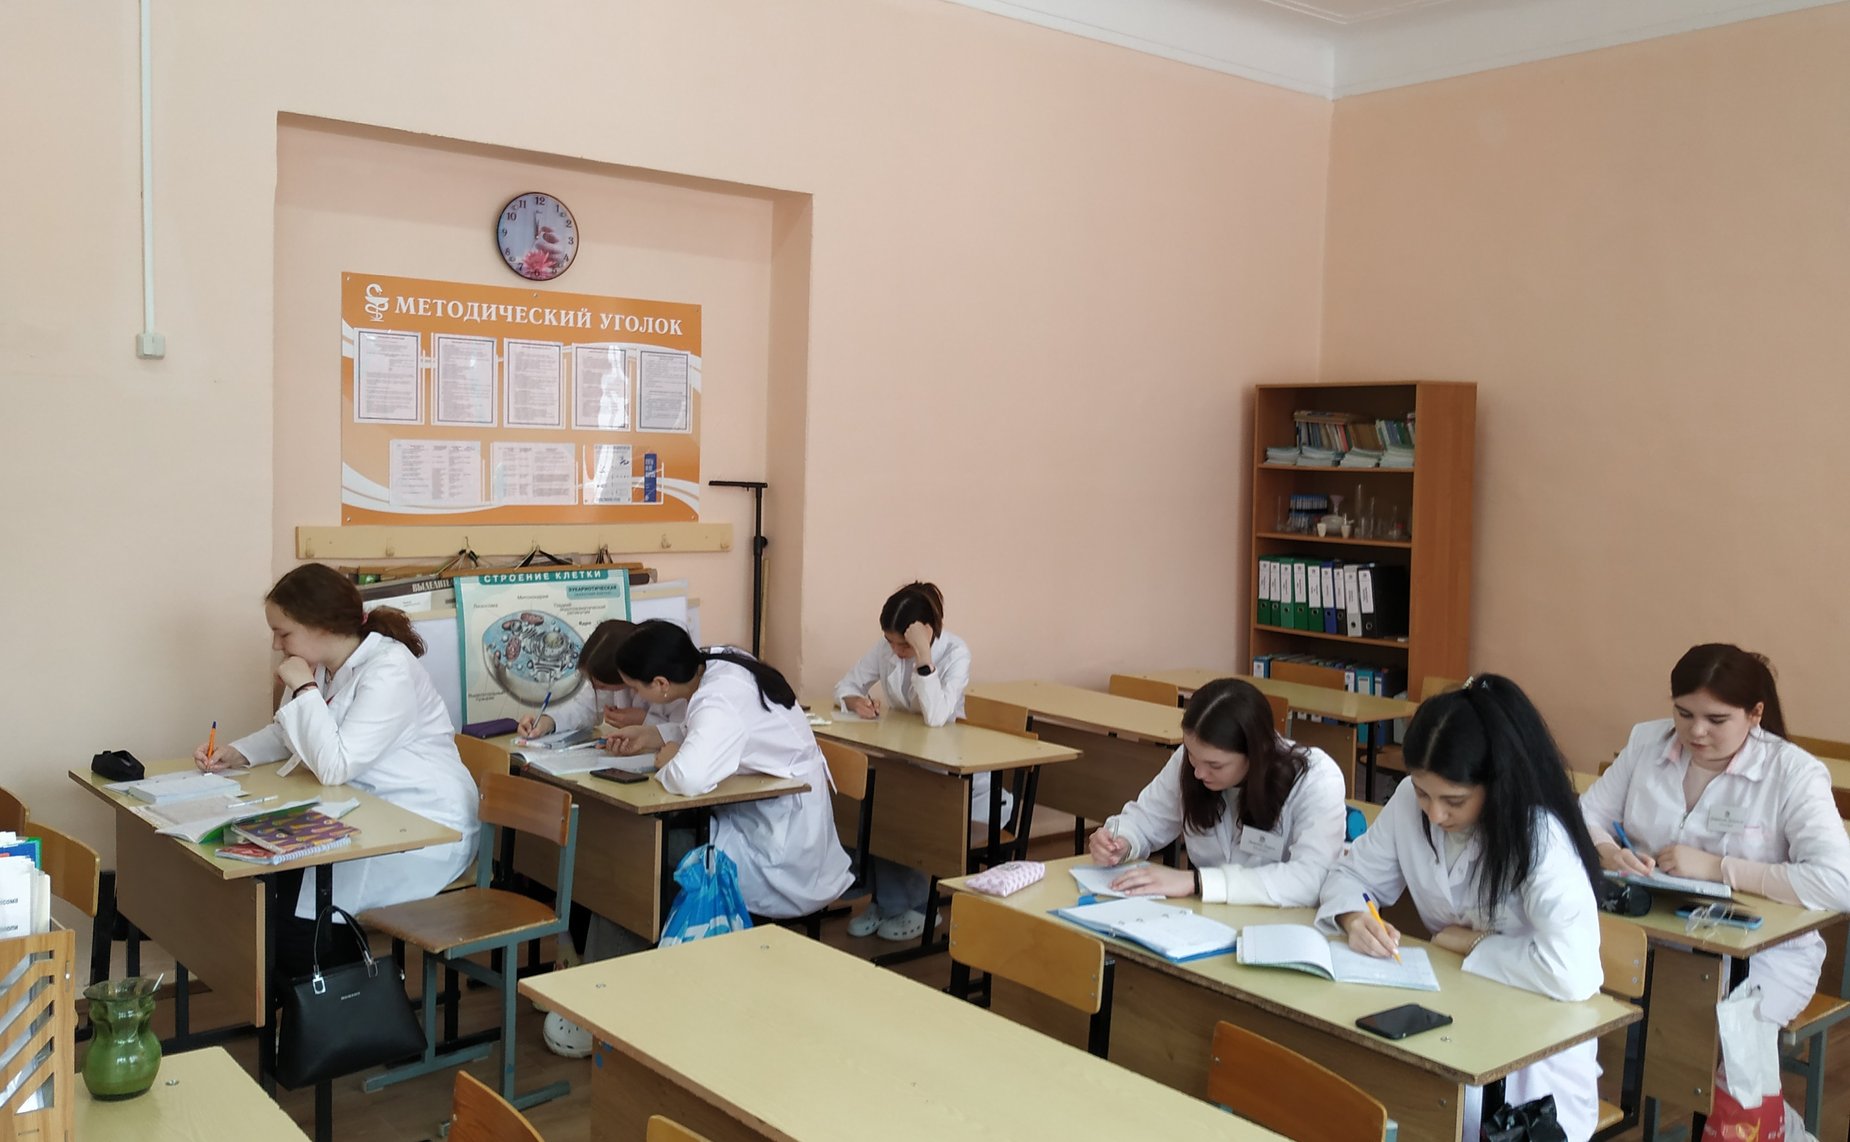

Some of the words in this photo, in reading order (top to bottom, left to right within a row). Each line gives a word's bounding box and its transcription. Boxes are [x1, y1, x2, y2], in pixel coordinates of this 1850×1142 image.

[519, 200, 527, 209] 11
[535, 196, 546, 206] 12
[506, 212, 517, 221] 10
[565, 219, 573, 228] 2
[502, 228, 508, 237] 9
[568, 237, 574, 245] 3
[504, 248, 510, 256] 8
[563, 253, 569, 262] 4
[517, 262, 524, 271] 7
[534, 269, 540, 277] 6
[394, 295, 592, 329] МЕТОДИЧЕСКИЙ
[599, 312, 684, 336] УГОЛОК
[483, 572, 550, 583] СТРОЕНИЕ
[555, 570, 602, 580] КЛЕТКИ
